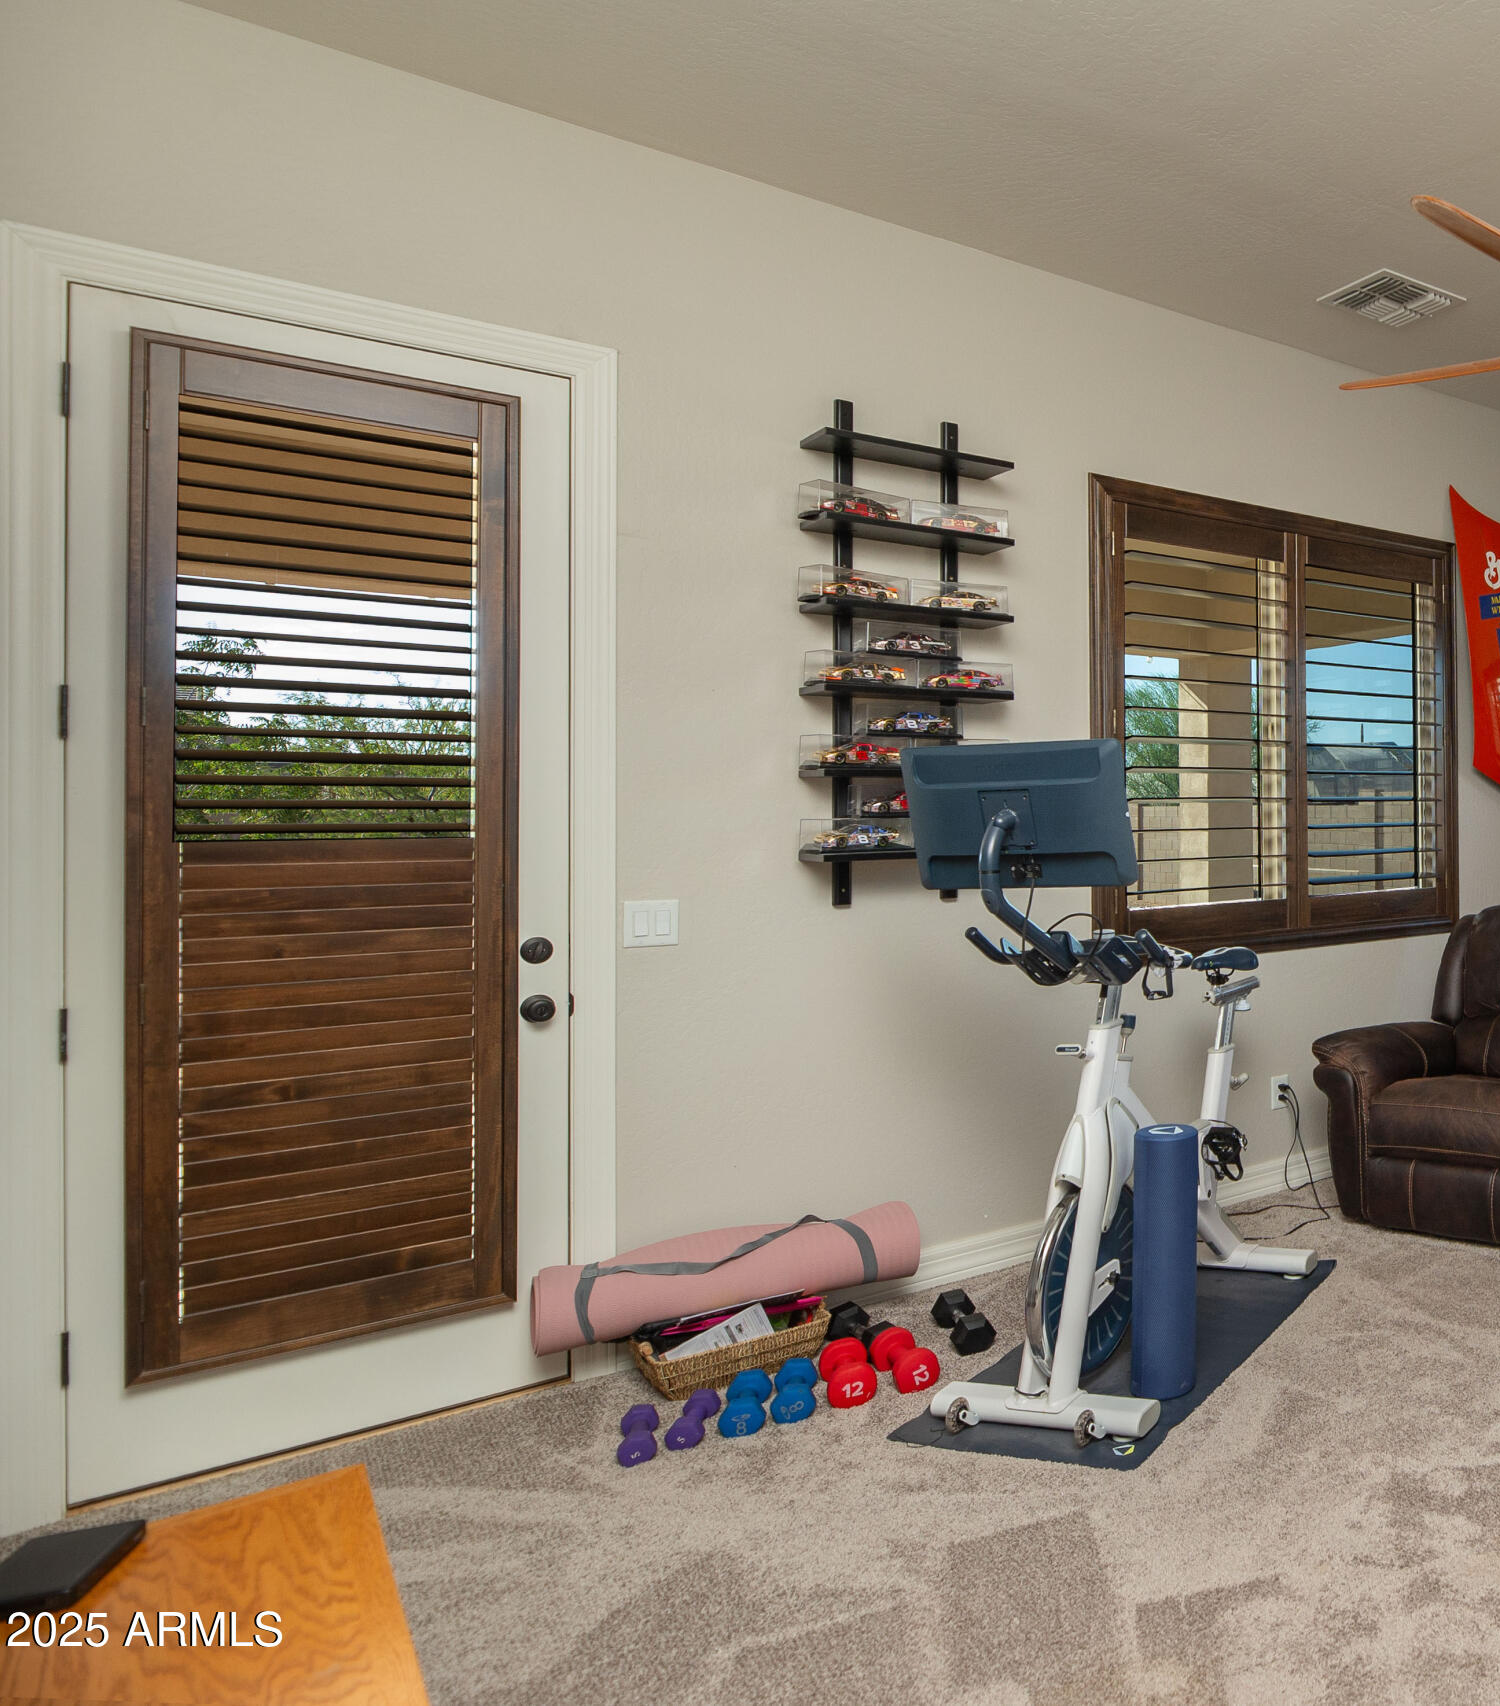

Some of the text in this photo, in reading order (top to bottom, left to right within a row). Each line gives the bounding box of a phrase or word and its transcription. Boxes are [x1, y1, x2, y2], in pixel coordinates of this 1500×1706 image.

[858, 585, 868, 594] 3
[909, 640, 920, 649] 3
[862, 670, 873, 678] 3
[905, 720, 918, 729] 8
[857, 834, 869, 844] 8
[912, 1364, 930, 1386] 12
[841, 1381, 865, 1398] 12
[736, 1421, 747, 1436] 8
